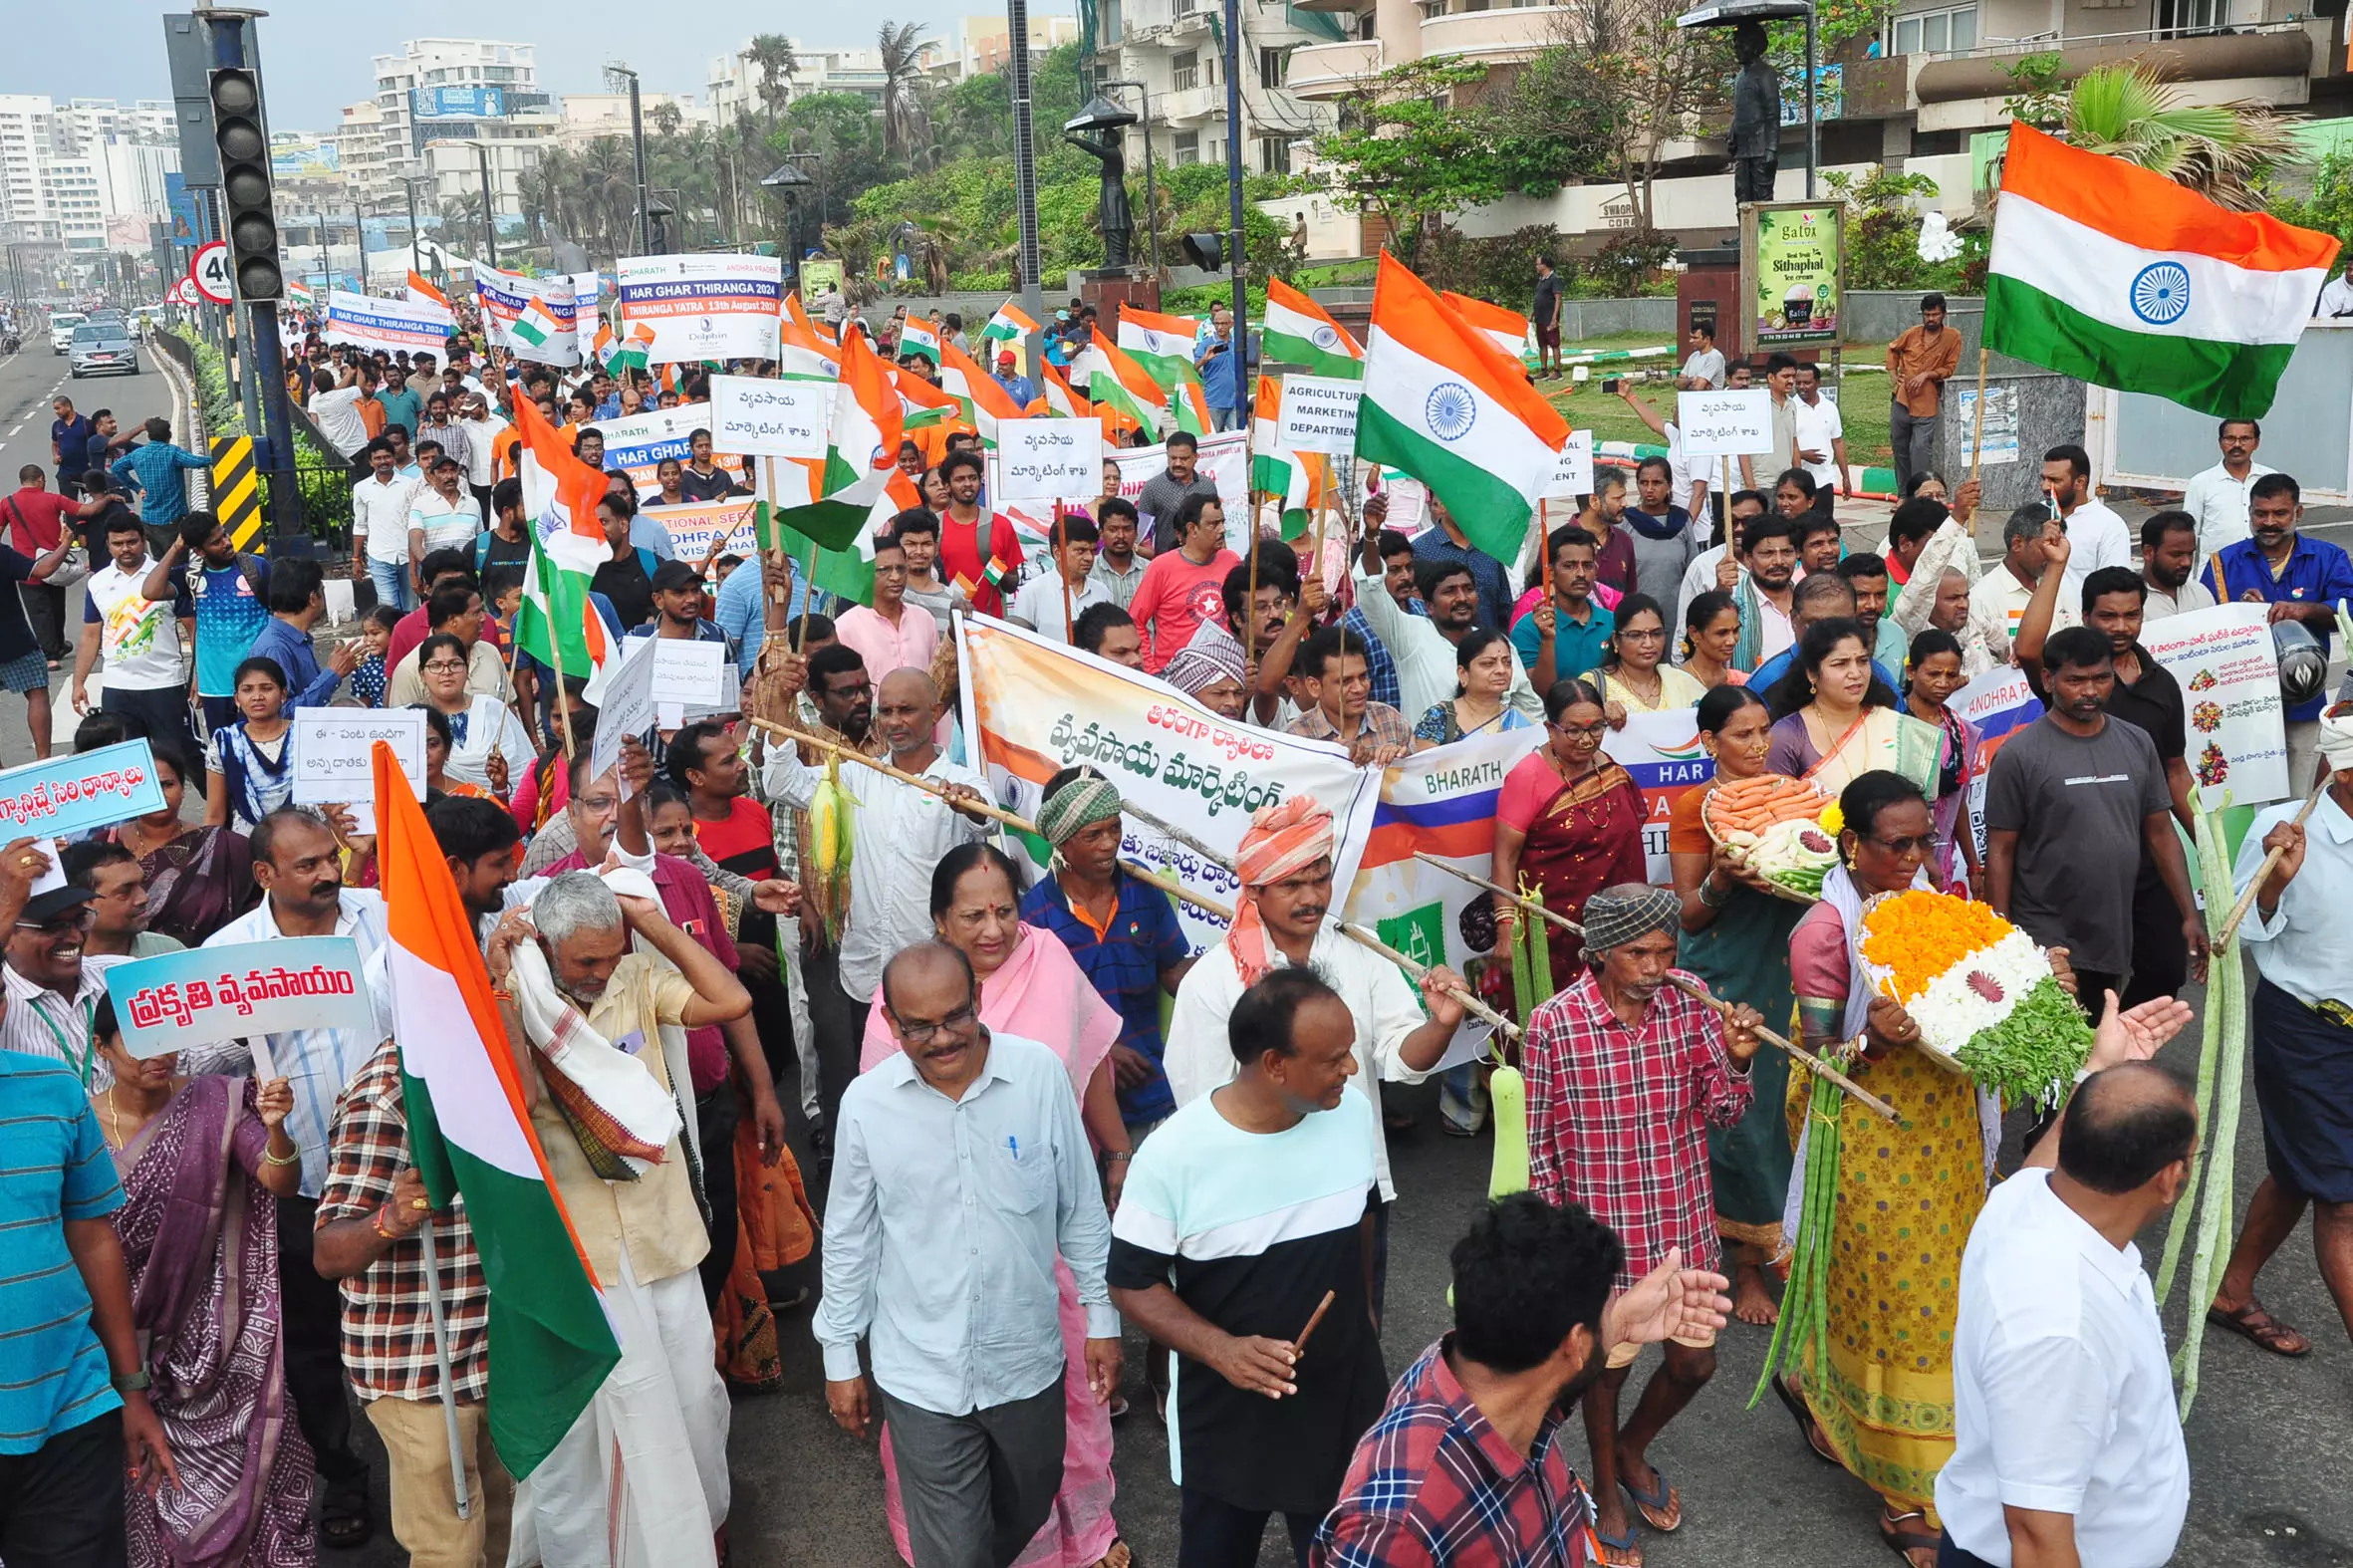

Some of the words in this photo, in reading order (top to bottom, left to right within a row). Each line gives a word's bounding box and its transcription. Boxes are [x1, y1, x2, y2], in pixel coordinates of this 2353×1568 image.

[629, 266, 666, 277] BHARATH
[1772, 257, 1824, 274] Sithaphal
[630, 286, 654, 299] HAR
[655, 284, 692, 297] GHAR
[692, 283, 755, 295] THIRANGA
[756, 283, 776, 296] 2024
[497, 295, 523, 309] GHAR
[629, 303, 673, 316] THIRANGA
[673, 301, 704, 313] YATRA
[708, 300, 730, 311] 13th
[730, 301, 760, 313] August
[336, 310, 352, 321] HAR
[353, 314, 377, 326] GHAR
[378, 319, 424, 332] THIRANGA
[424, 325, 444, 335] 2024
[739, 392, 795, 408] వ్యవసాయ
[1288, 386, 1361, 401] AGRICULTUR
[1296, 405, 1356, 419] MARKETIN
[1701, 400, 1746, 417] వ్యవసాయ
[1290, 422, 1356, 437] DEPARTMEN
[1024, 431, 1074, 451] వ్యవసాయ
[616, 450, 649, 465] HAR
[716, 454, 743, 468] 13th
[1967, 684, 2018, 716] ANDHRA
[1147, 704, 1209, 740] తిరంగా
[1049, 713, 1161, 779] వ్యవసాయ
[1425, 760, 1503, 795] BHARATH
[1659, 763, 1703, 783] HAR
[127, 979, 214, 1030] ప్రకృతి
[215, 964, 355, 1017] వ్యవసాయం
